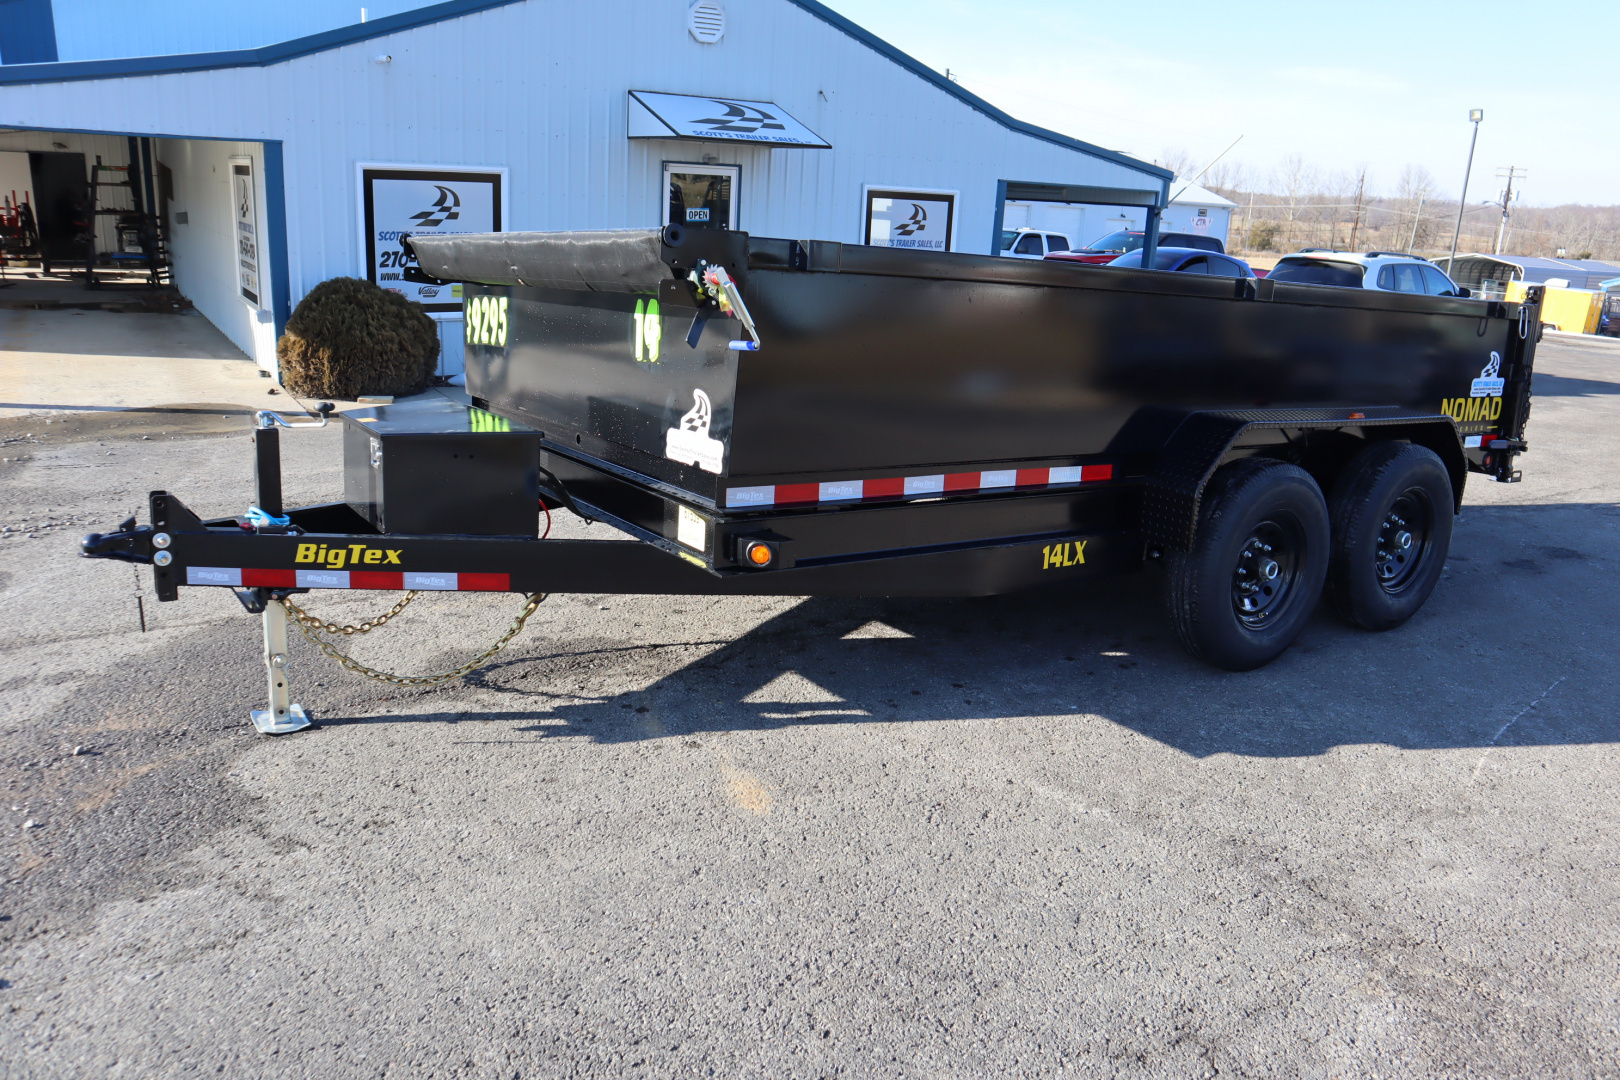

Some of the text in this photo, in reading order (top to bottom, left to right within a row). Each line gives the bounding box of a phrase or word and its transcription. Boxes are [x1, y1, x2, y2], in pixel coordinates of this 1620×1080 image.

[692, 130, 732, 138] SCOTT'S
[735, 133, 770, 141] TRAILER
[688, 210, 708, 220] OPEN
[896, 239, 916, 248] TRAILER
[917, 240, 934, 249] SALES,
[418, 286, 440, 297] Valley
[1440, 396, 1503, 422] NOMAD
[1458, 425, 1484, 433] ERIES
[294, 543, 403, 569] BigTex
[1042, 540, 1088, 570] 14LX
[197, 571, 230, 581] BigTex
[306, 574, 338, 583] BigTex
[415, 576, 446, 586] BigTex
